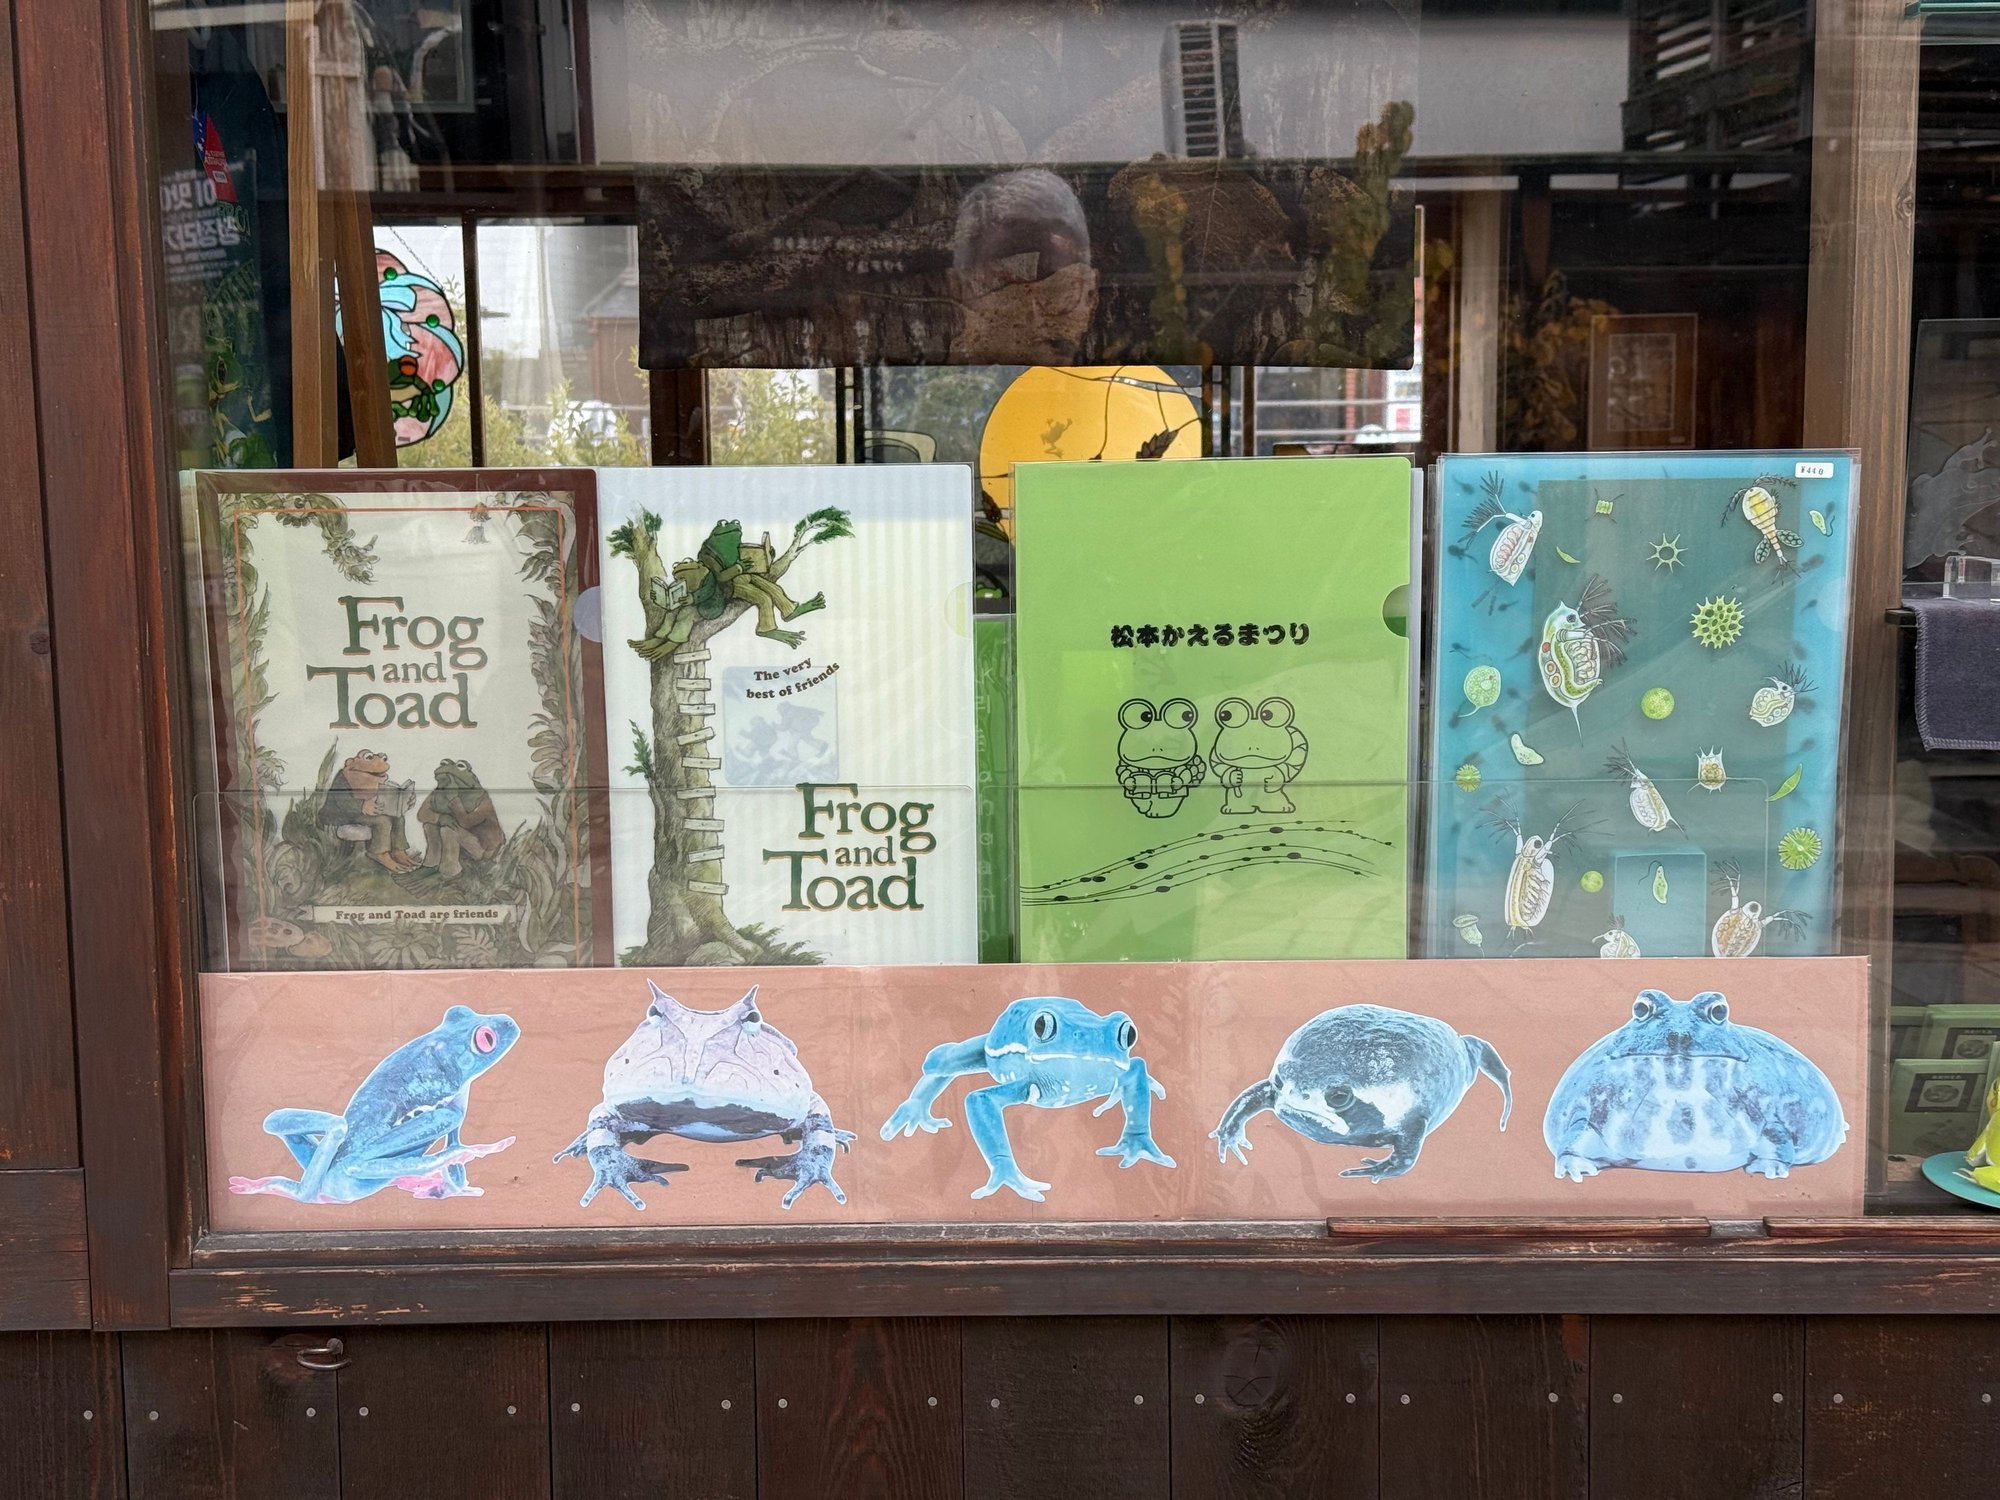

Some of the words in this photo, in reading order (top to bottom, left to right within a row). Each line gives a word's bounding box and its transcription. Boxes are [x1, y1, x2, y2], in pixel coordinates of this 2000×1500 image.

[1800, 466, 1824, 475] ¥440
[338, 595, 488, 670] Frog
[1110, 622, 1310, 648] 松本かえるまつり
[382, 651, 447, 683] and
[746, 688, 776, 699] best
[778, 685, 793, 697] of
[795, 662, 840, 692] friends
[753, 671, 780, 681] The
[782, 658, 812, 676] very
[306, 664, 478, 729] Toad
[795, 782, 937, 854] Frog
[835, 835, 896, 866] and
[762, 848, 924, 912] Toad
[335, 910, 365, 922] Frog
[368, 910, 392, 919] and
[395, 910, 426, 919] Toad
[430, 911, 450, 919] are
[453, 909, 498, 919] friends
